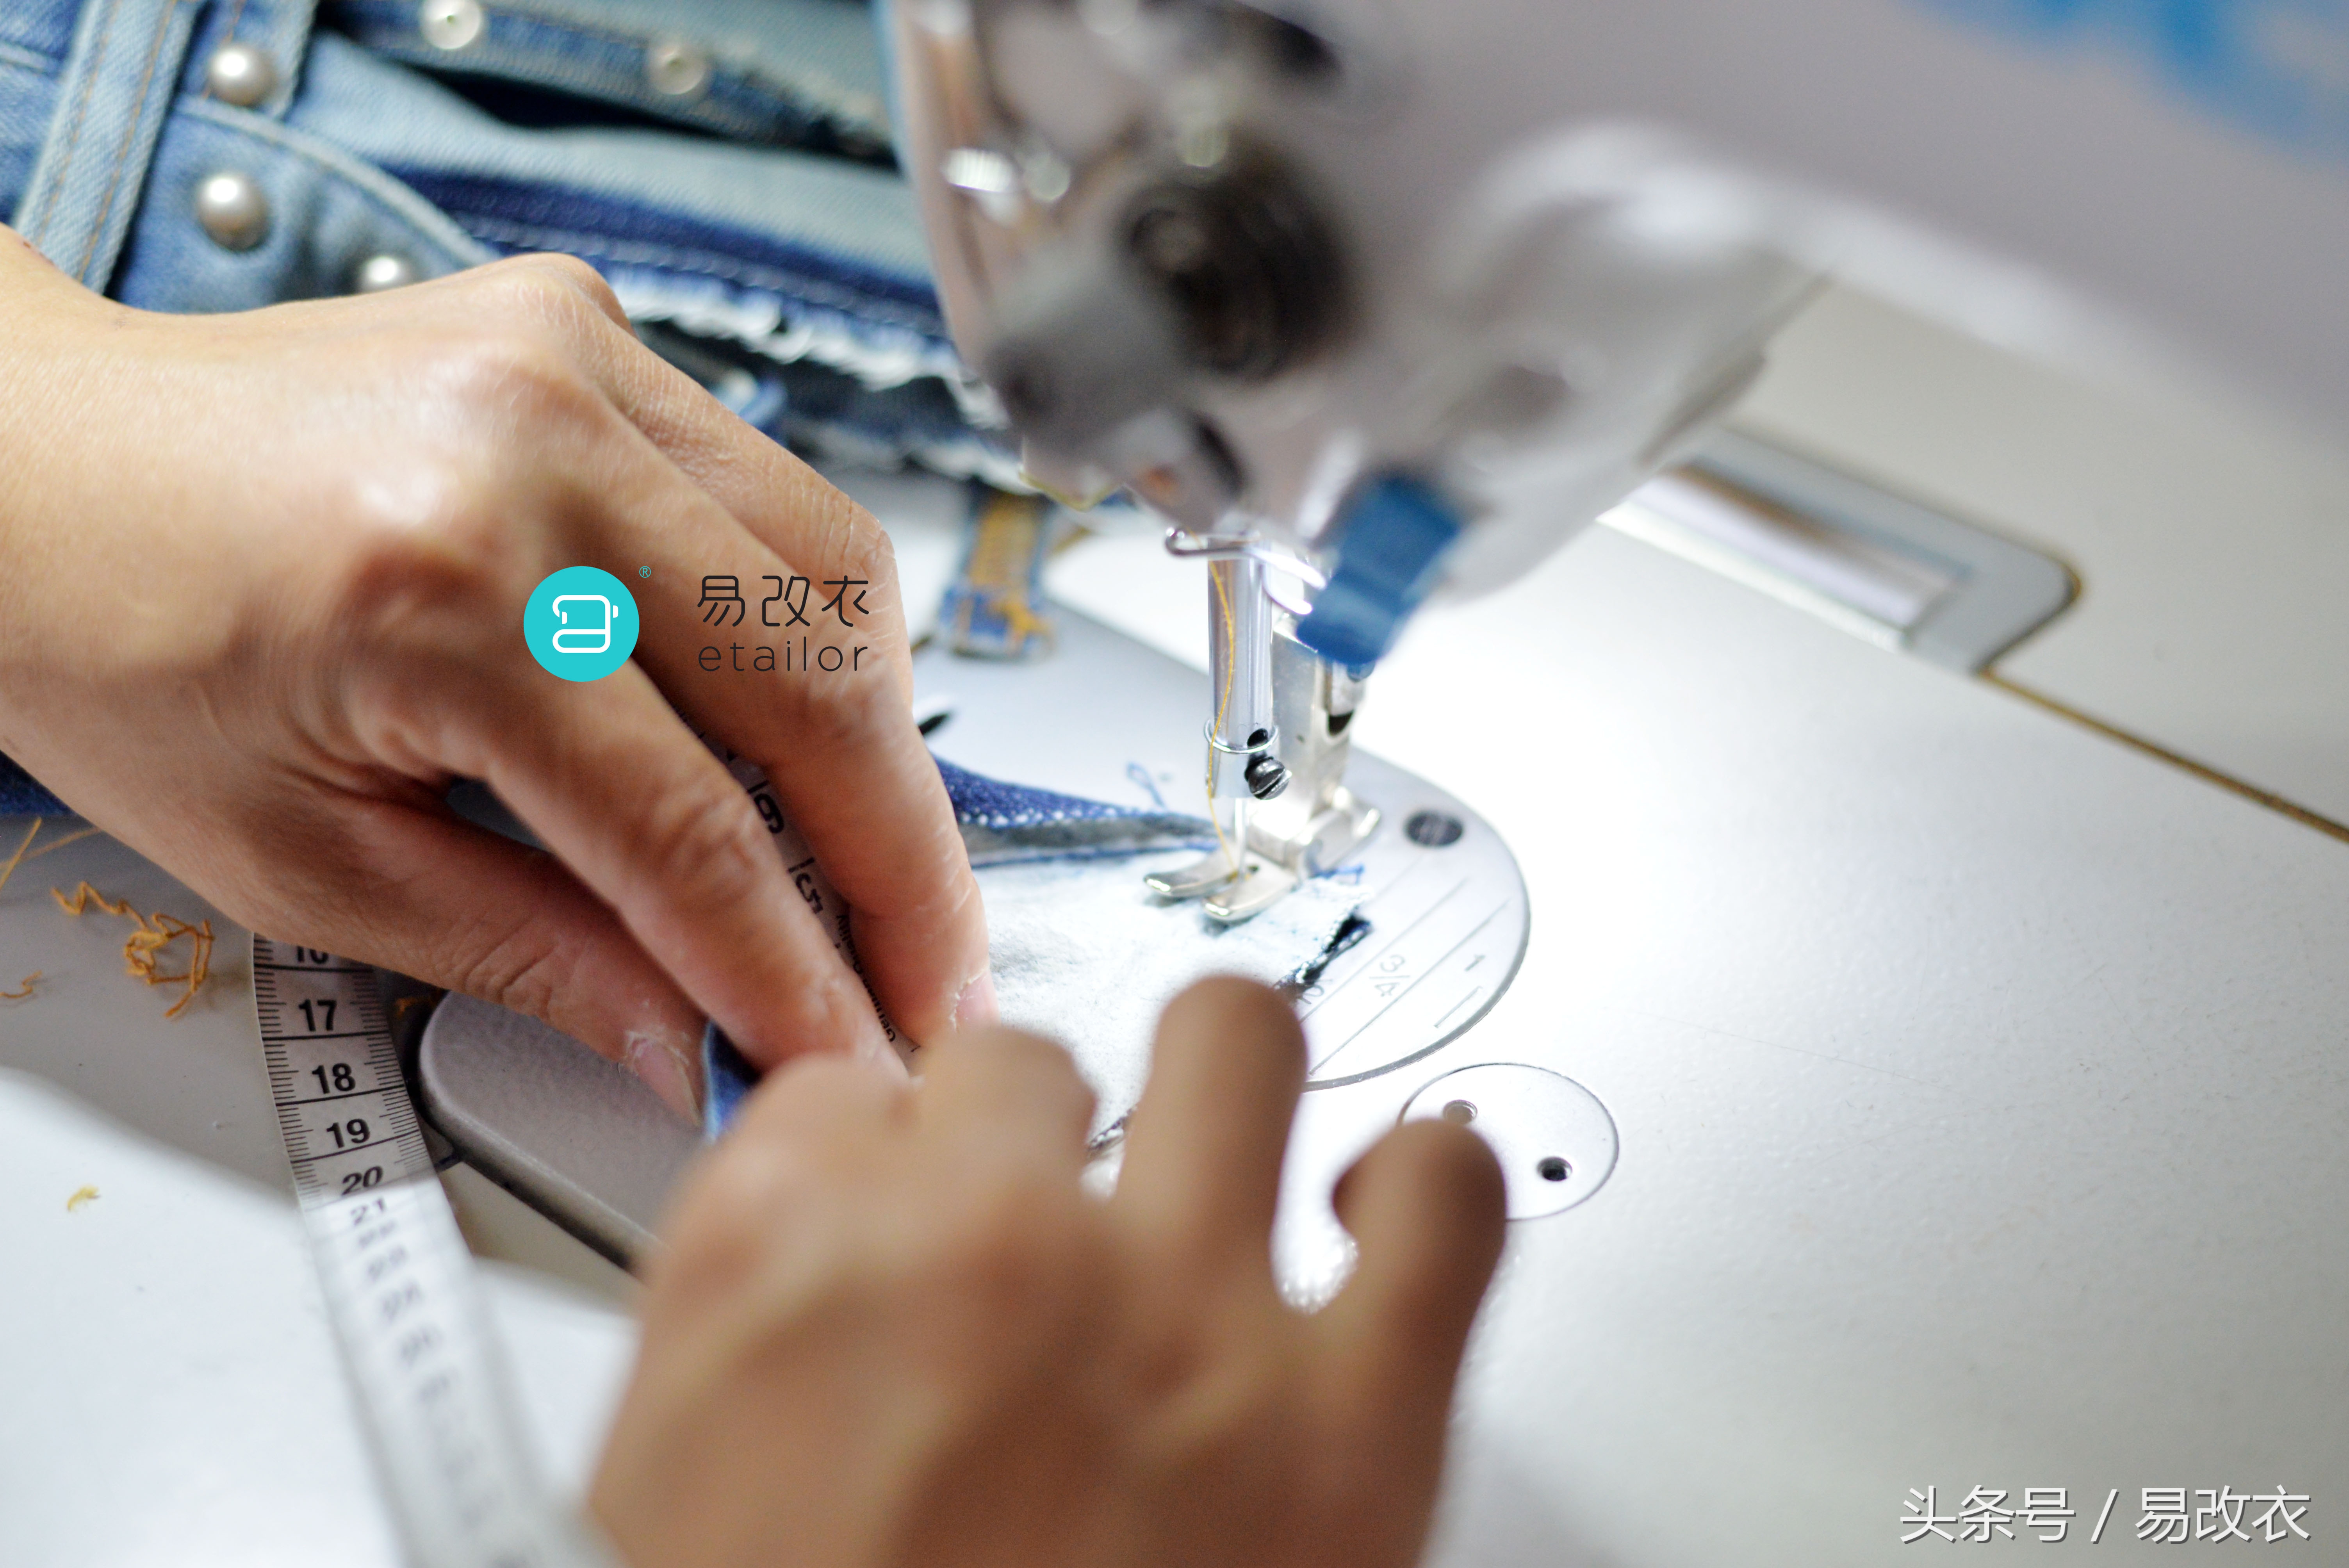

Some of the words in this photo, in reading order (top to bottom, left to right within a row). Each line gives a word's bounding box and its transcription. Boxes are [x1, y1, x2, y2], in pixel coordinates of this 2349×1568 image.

[754, 793, 784, 834] 6
[795, 872, 823, 914] 5
[298, 999, 337, 1032] 17
[312, 1063, 356, 1094] 18
[326, 1118, 371, 1148] 19
[341, 1165, 383, 1196] 20
[350, 1197, 386, 1226] 21
